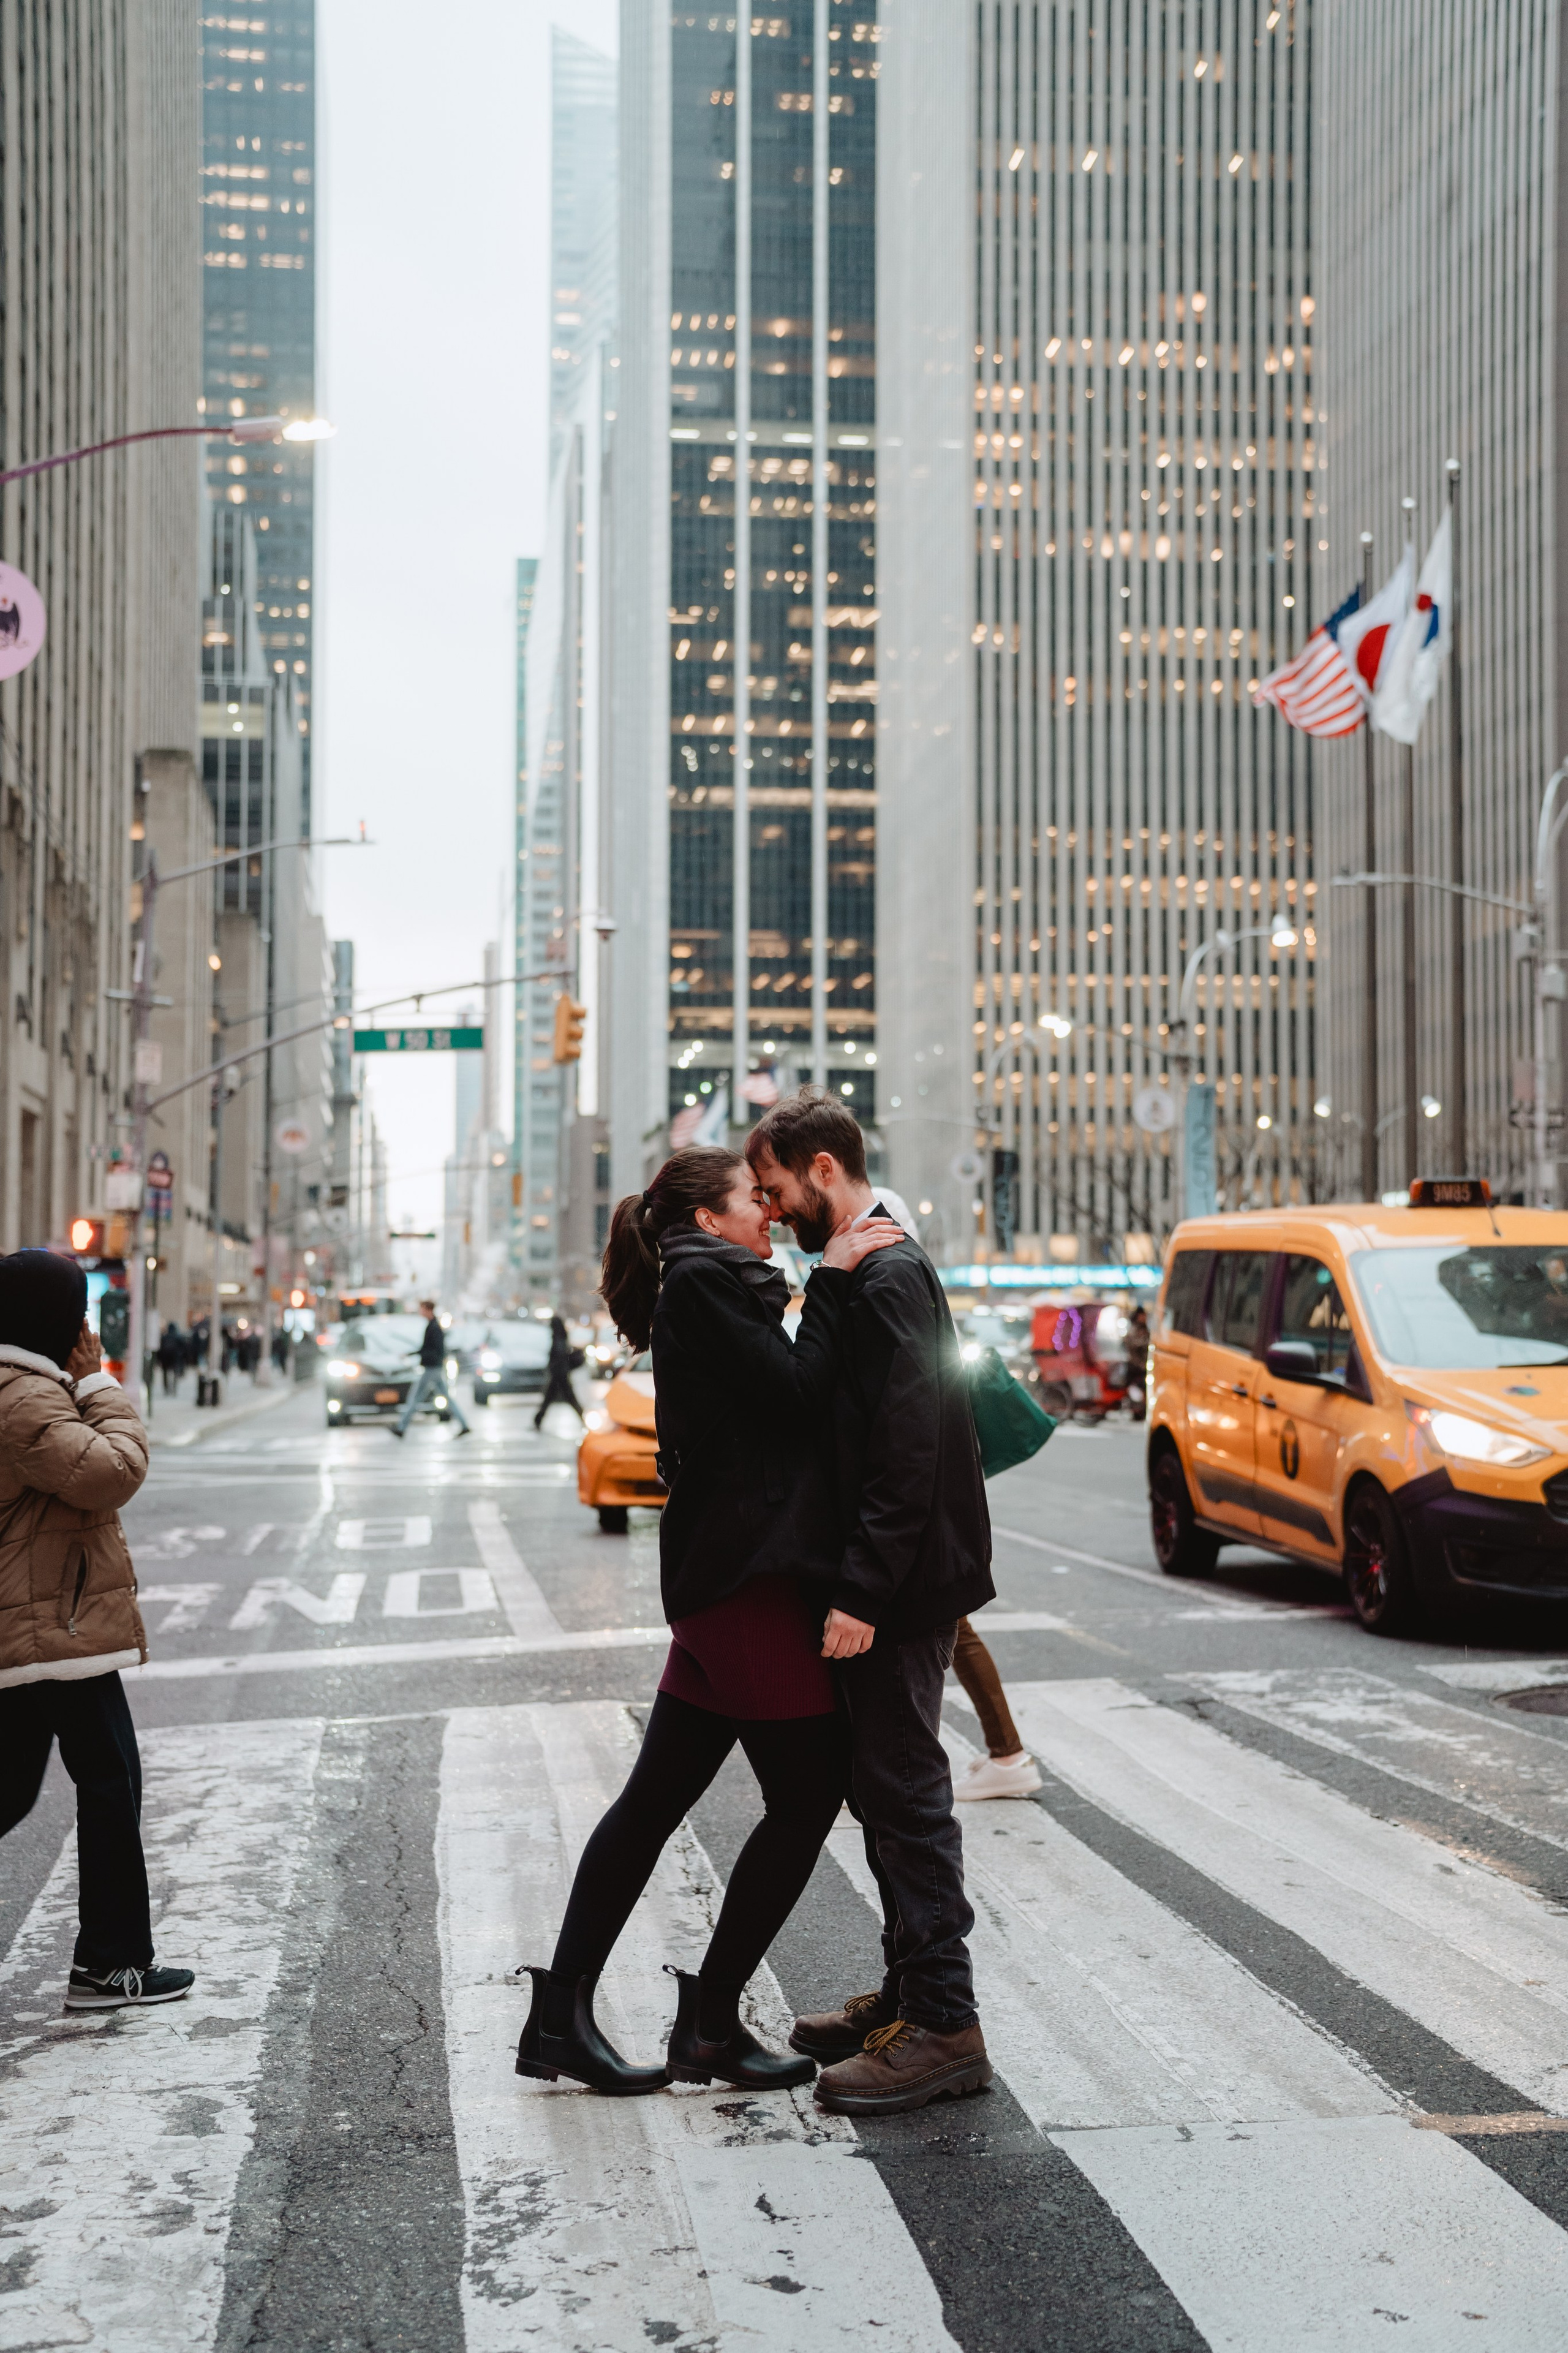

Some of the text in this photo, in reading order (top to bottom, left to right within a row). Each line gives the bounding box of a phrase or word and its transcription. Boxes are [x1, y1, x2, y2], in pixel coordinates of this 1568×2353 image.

[385, 1032, 401, 1050] W
[404, 1030, 428, 1050] 50
[135, 1566, 500, 1634] ONL
